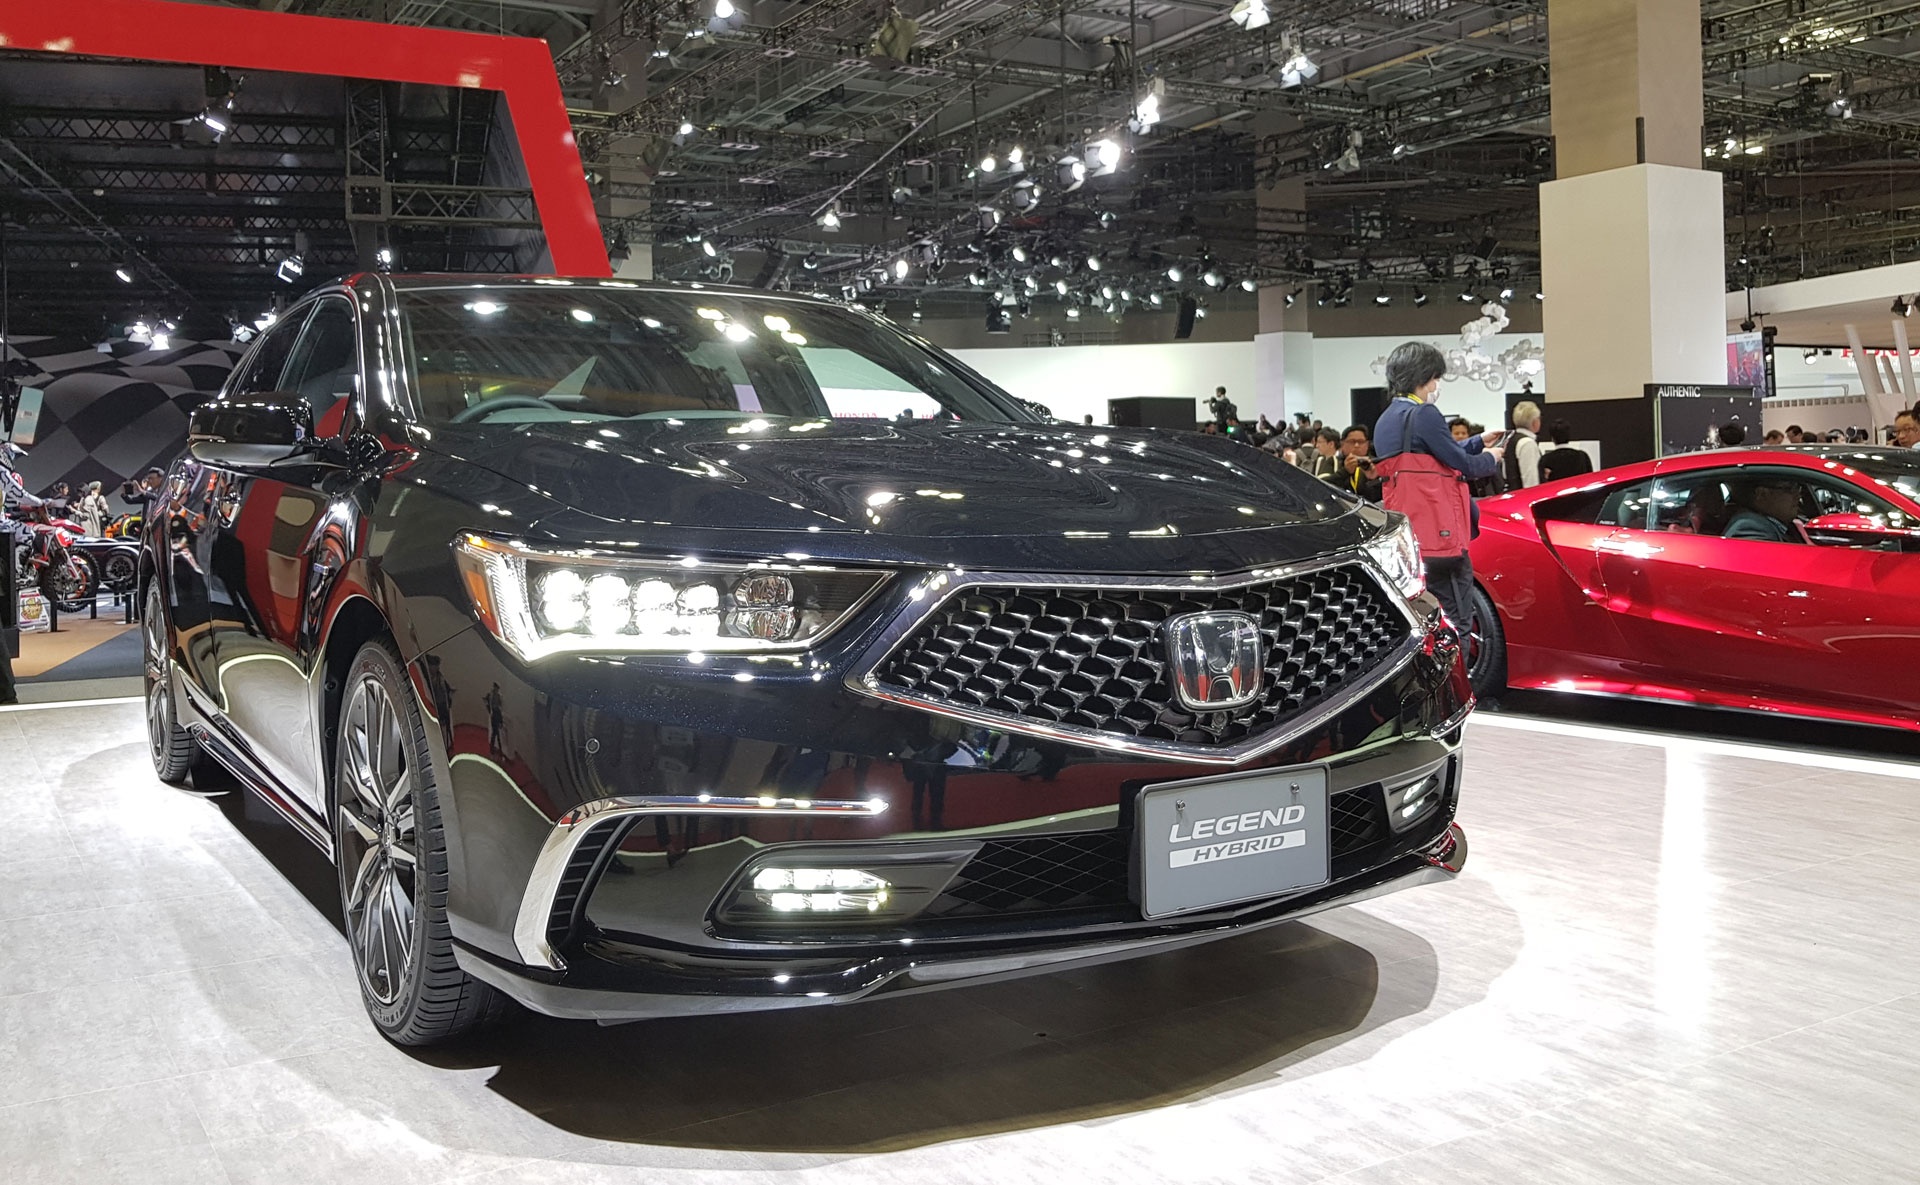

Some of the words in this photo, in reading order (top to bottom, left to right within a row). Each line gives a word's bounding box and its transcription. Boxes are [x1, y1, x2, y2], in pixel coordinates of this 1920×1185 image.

[1657, 386, 1701, 398] AUTHENTIC
[1168, 804, 1305, 843] LEGEND
[1193, 835, 1285, 862] HYBRID
